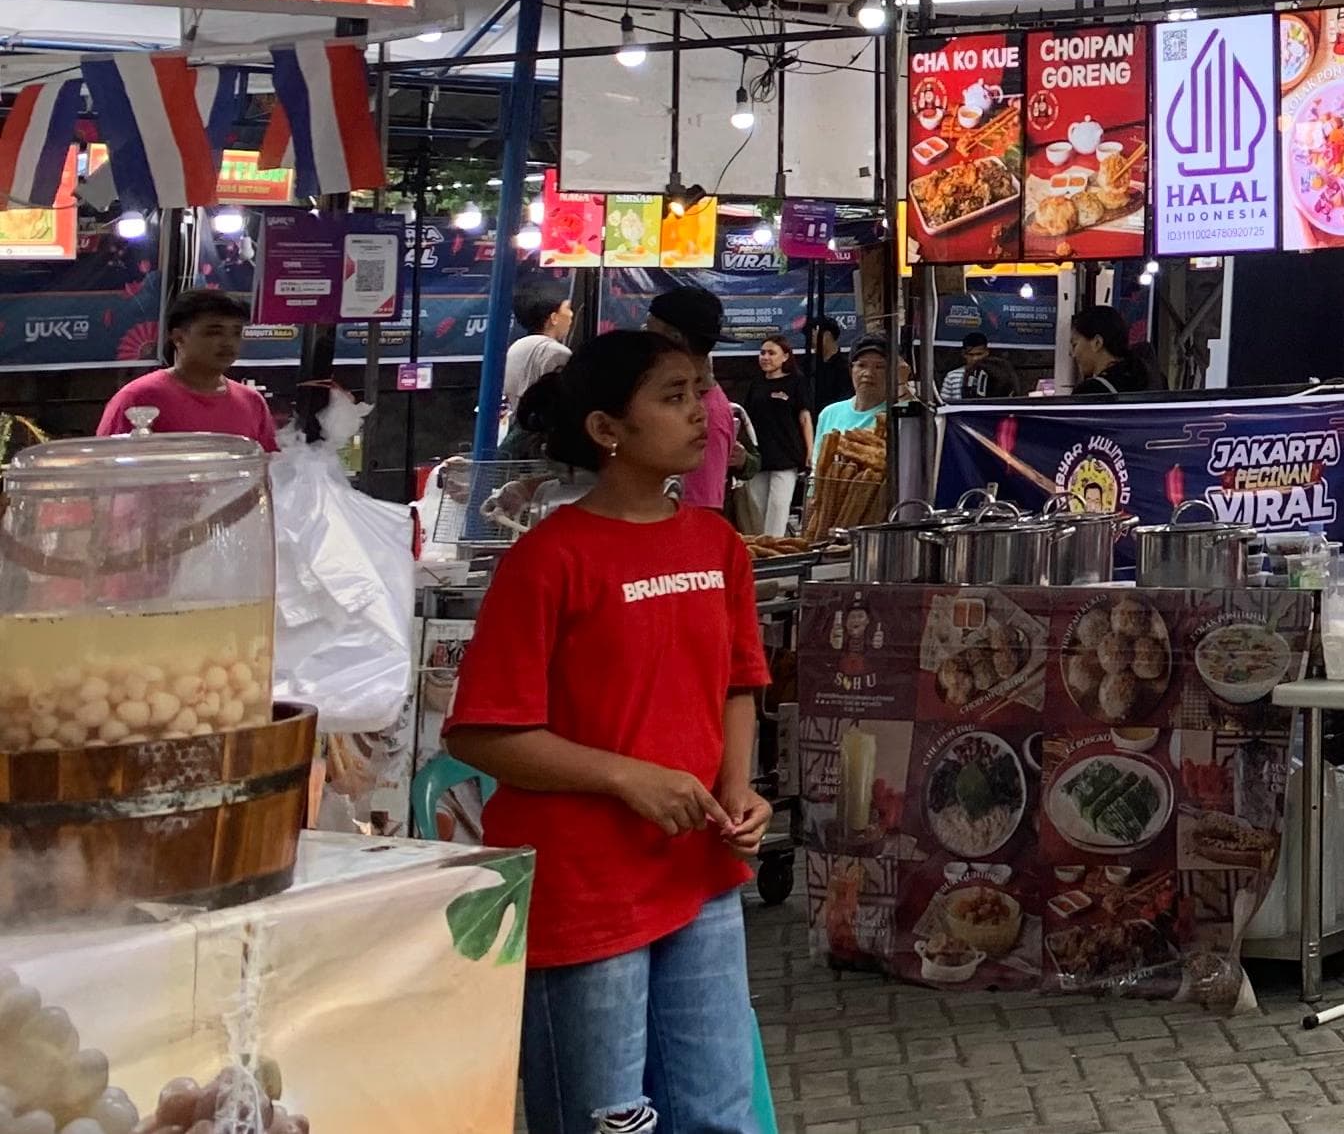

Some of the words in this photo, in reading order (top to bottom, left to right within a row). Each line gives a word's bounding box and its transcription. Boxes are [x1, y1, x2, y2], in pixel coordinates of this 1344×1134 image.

[912, 54, 949, 73] CHA
[953, 49, 978, 70] KO
[982, 47, 1019, 69] KUE
[1040, 33, 1134, 61] CHOIPAN
[1041, 62, 1131, 89] GORENG
[1166, 180, 1268, 207] HALAL
[1166, 208, 1268, 223] INDONESIA
[722, 252, 786, 270] VIRAL
[1208, 432, 1339, 473] JAKARTA
[1055, 443, 1084, 494] BYAR
[1234, 463, 1313, 490] PECINAN
[1208, 480, 1336, 528] VIRAL
